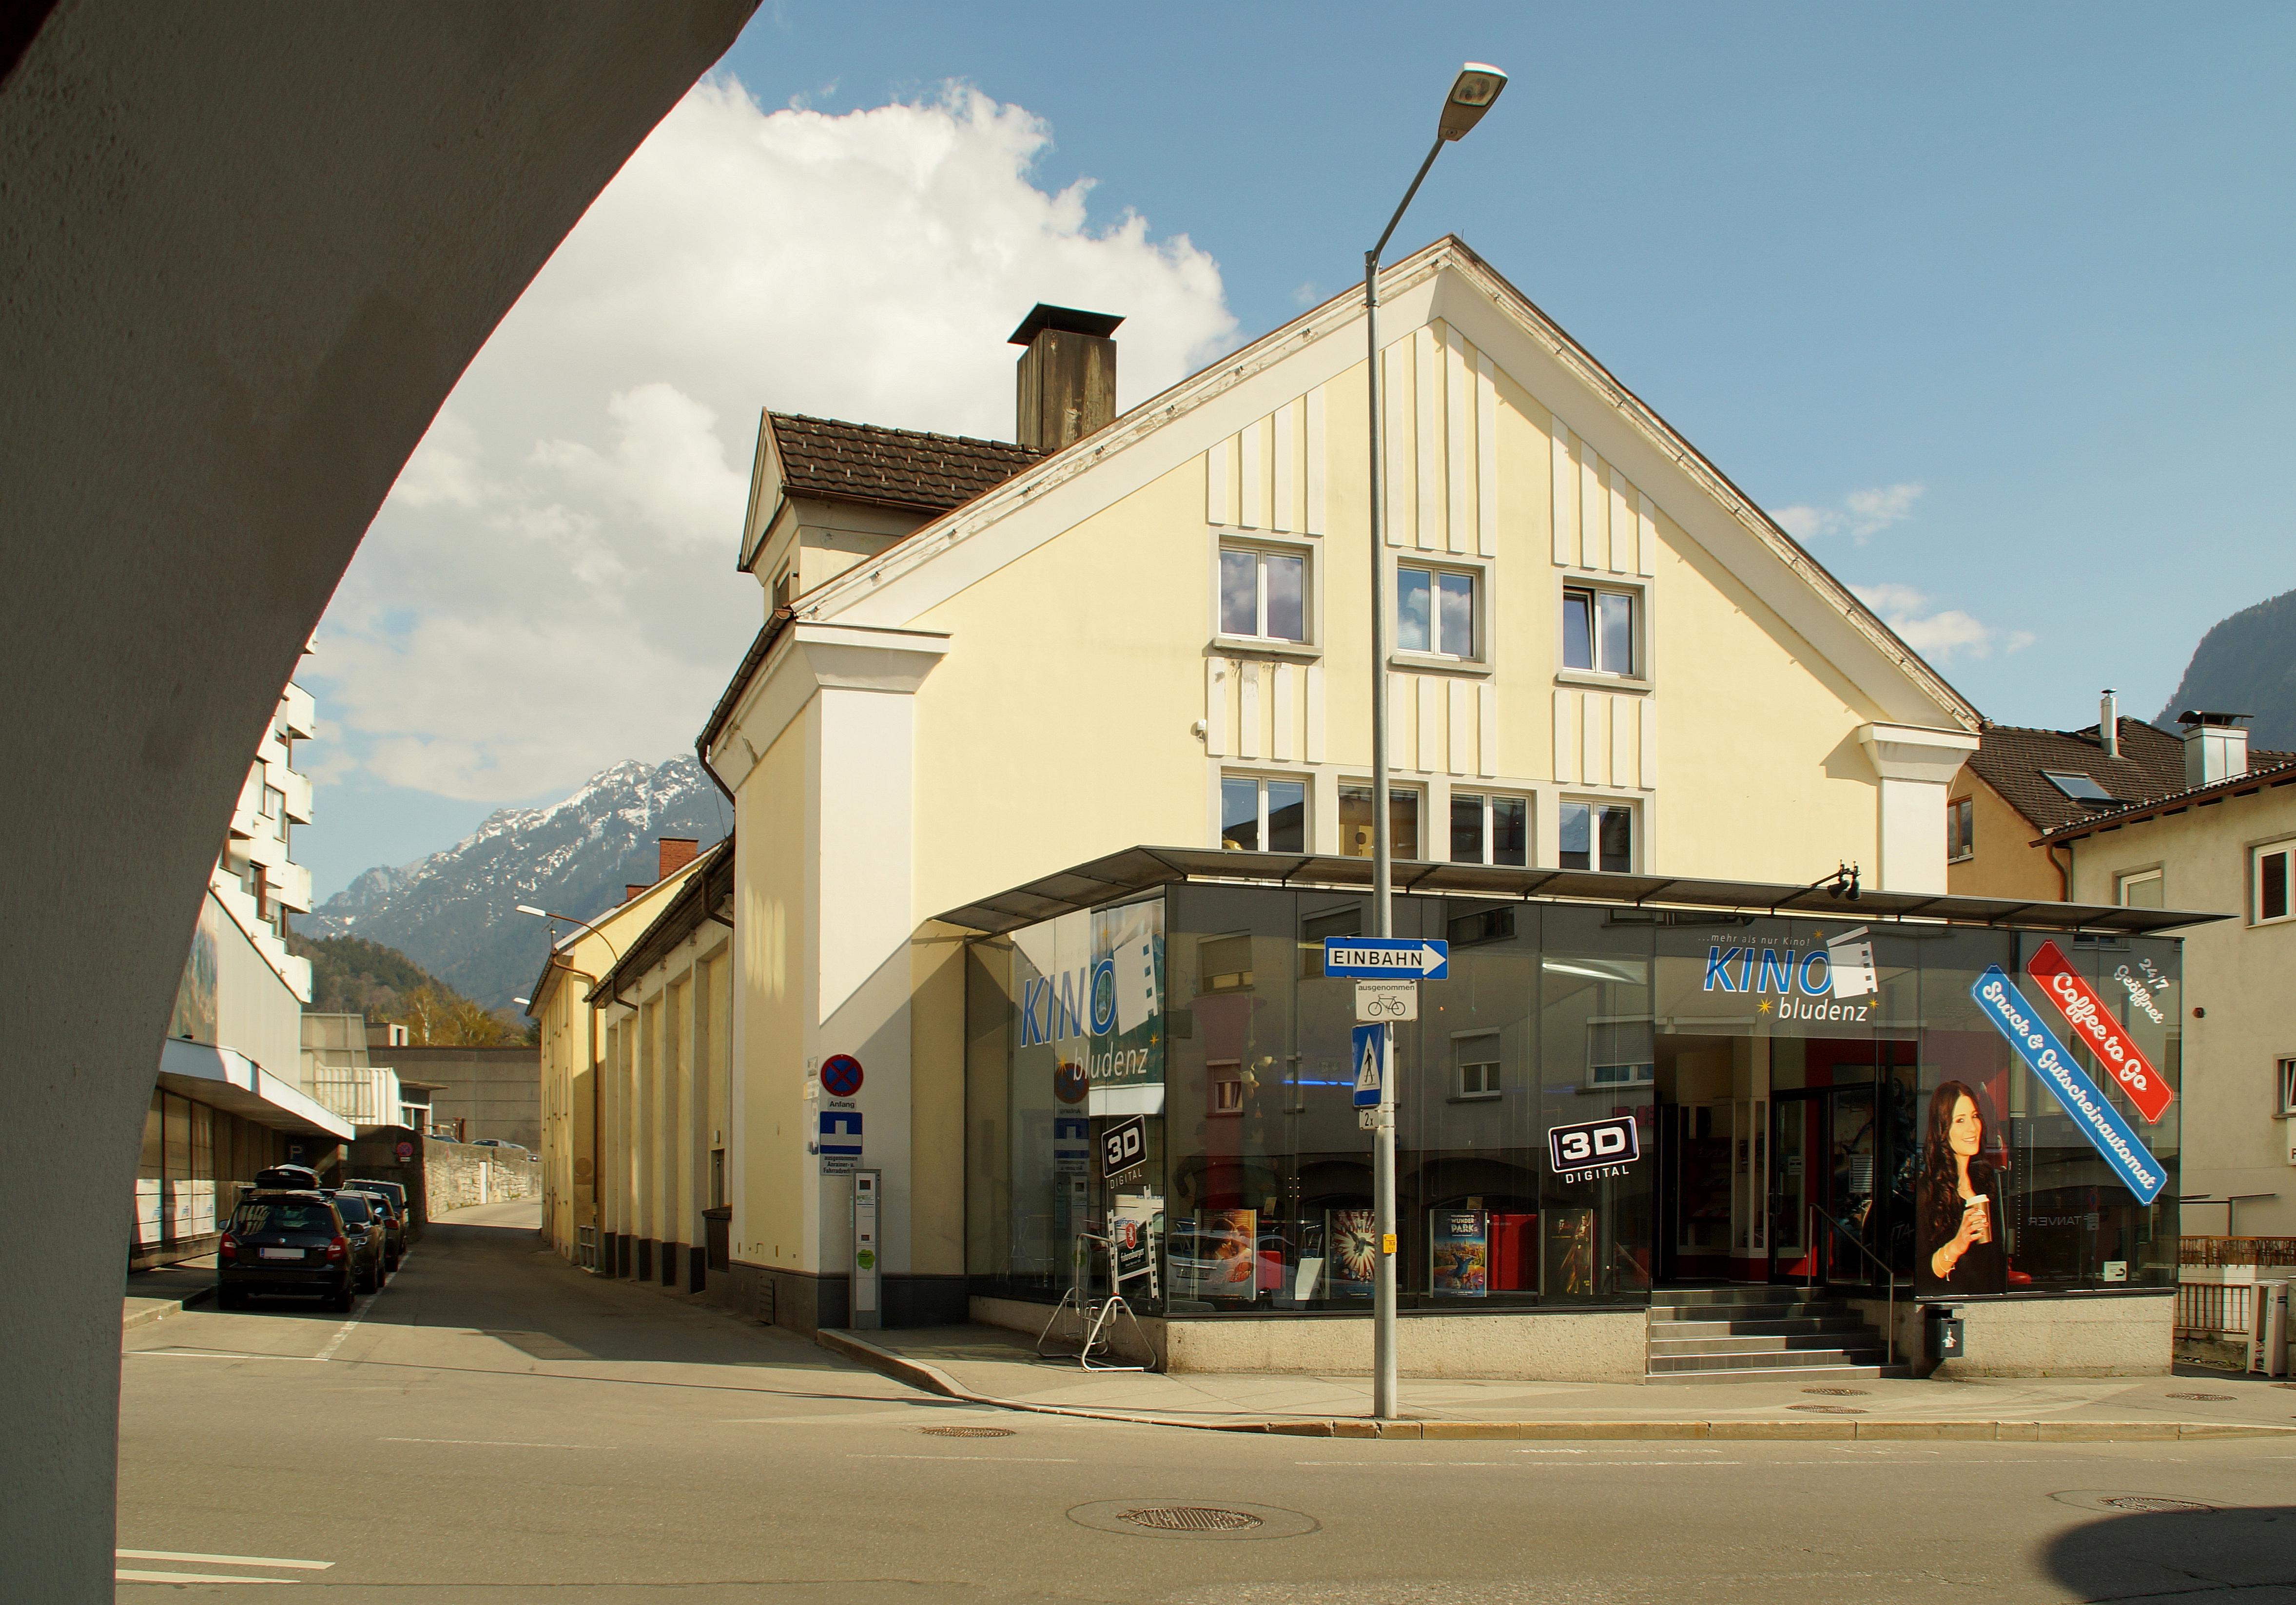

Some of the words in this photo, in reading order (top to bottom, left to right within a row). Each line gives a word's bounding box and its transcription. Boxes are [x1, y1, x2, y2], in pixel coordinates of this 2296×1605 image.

[1742, 935, 1756, 944] als
[1783, 937, 1810, 946] Kino!
[1334, 950, 1422, 966] EINBAHN
[1703, 946, 1833, 996] KINO
[2139, 958, 2169, 990] 24/7
[1021, 958, 1119, 1048] KINO
[1778, 997, 1868, 1022] bludenz
[2114, 964, 2164, 1024] Geöffnet
[2052, 971, 2107, 1041] Coffee
[2104, 1035, 2124, 1062] to
[2120, 1059, 2147, 1091] Go
[1073, 1041, 1148, 1081] bludenz
[1983, 981, 2028, 1037] Snack
[2027, 1033, 2044, 1049] &
[2038, 1048, 2156, 1189] Gutscheinautomat
[829, 1101, 855, 1109] Anfang
[1107, 1127, 1140, 1164] 3D
[1562, 1127, 1626, 1160] 3D
[1109, 1168, 1143, 1189] DIGITAL
[1565, 1165, 1629, 1183] DIGITAL
[1451, 1224, 1474, 1233] PARK
